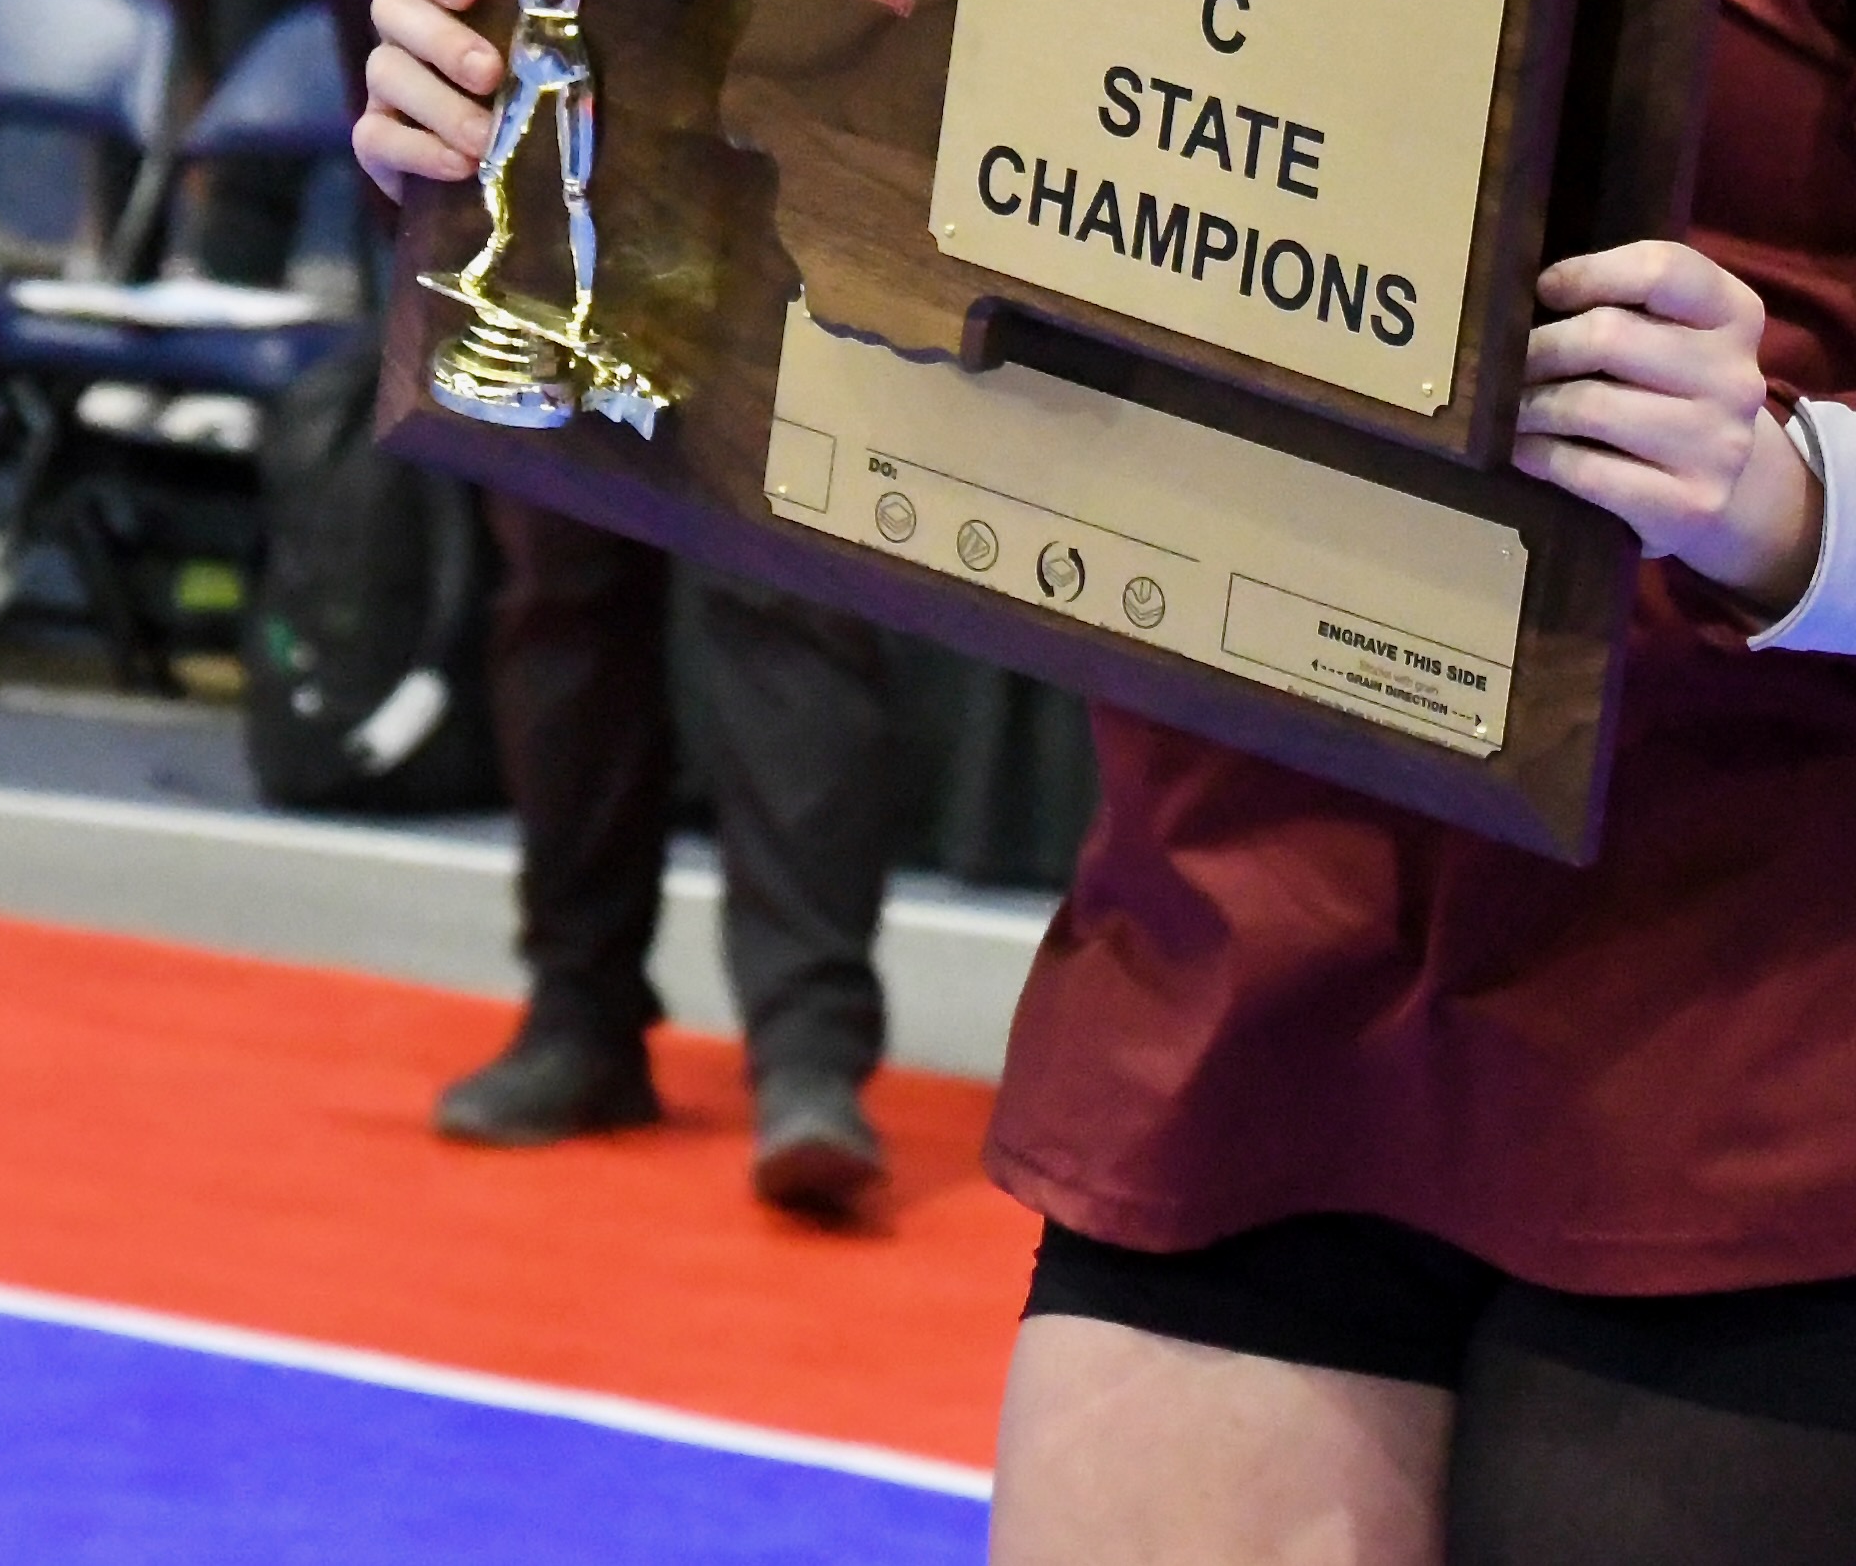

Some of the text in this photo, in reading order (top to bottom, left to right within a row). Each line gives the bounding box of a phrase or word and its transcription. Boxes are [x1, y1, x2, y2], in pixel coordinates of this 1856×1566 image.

[1098, 66, 1325, 200] STATE
[977, 145, 1417, 347] CHAMPIONS
[1317, 621, 1398, 662] ENGRAVE
[1403, 649, 1442, 676] THIS
[1446, 665, 1487, 692] SIDE
[1346, 672, 1382, 692] GRAIN
[1385, 684, 1447, 715] DIRECTION
